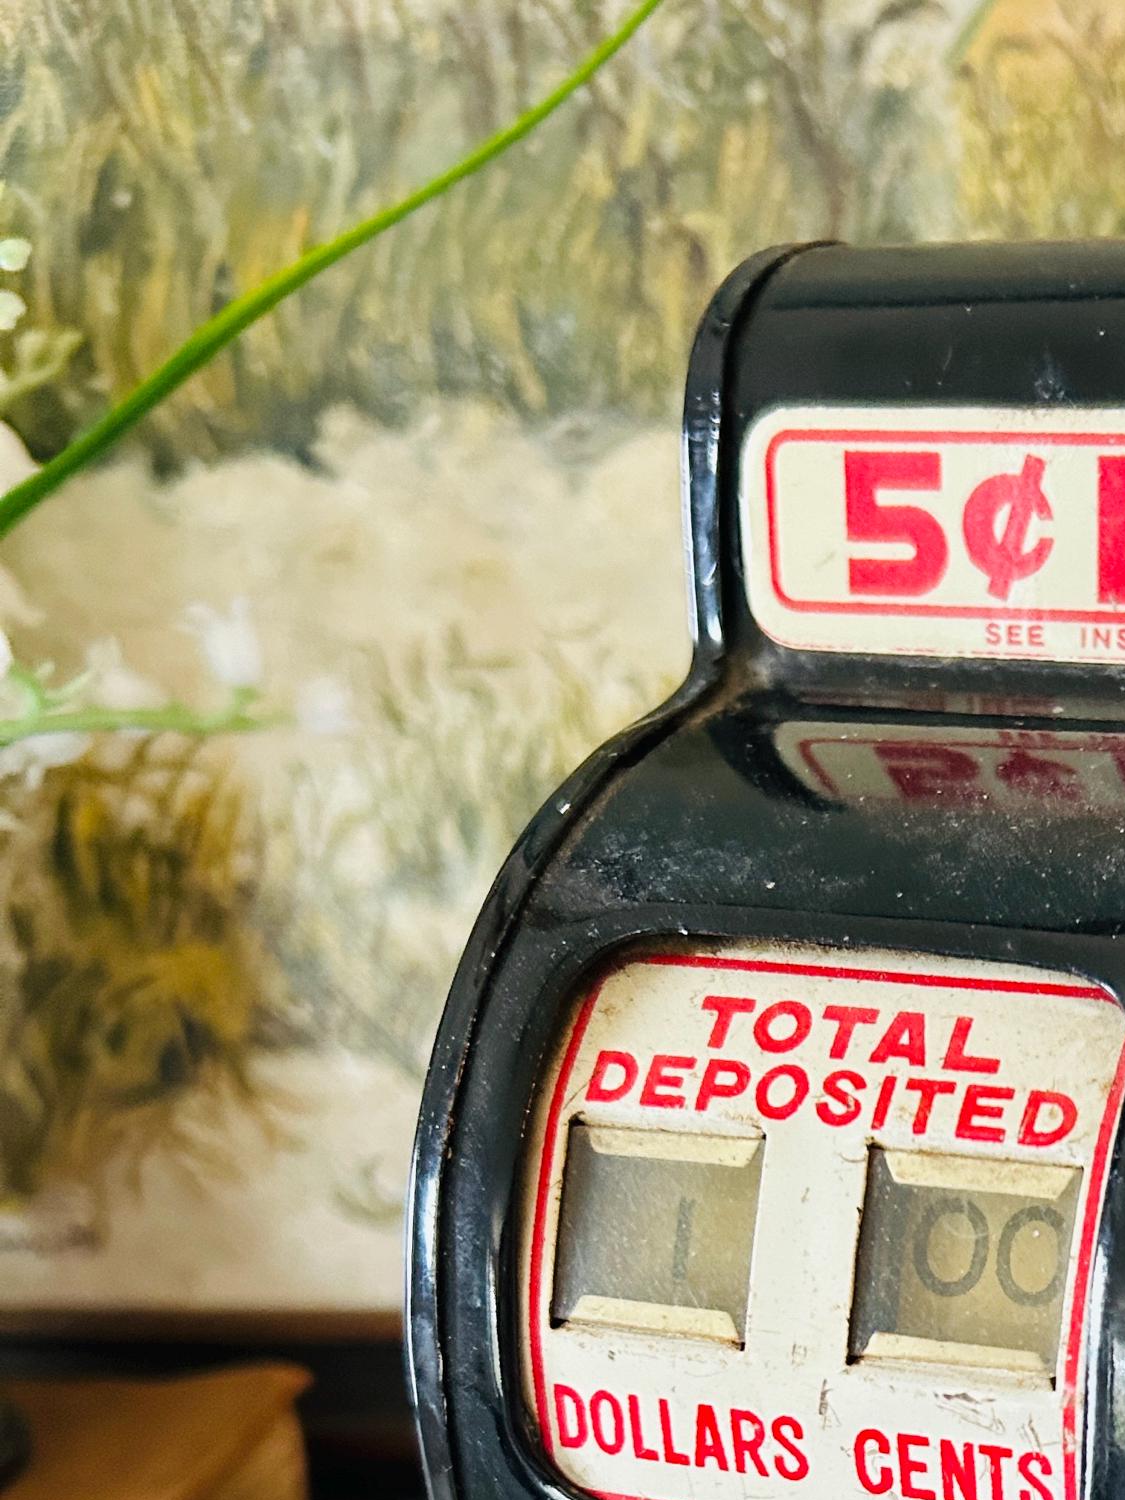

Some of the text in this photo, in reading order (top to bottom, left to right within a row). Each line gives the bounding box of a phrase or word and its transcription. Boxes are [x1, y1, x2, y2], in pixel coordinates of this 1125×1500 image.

[985, 622, 1045, 648] SEE
[700, 995, 1001, 1077] TOTAL
[584, 1048, 1080, 1149] DEPOSITED
[552, 1383, 811, 1483] DOLLARS
